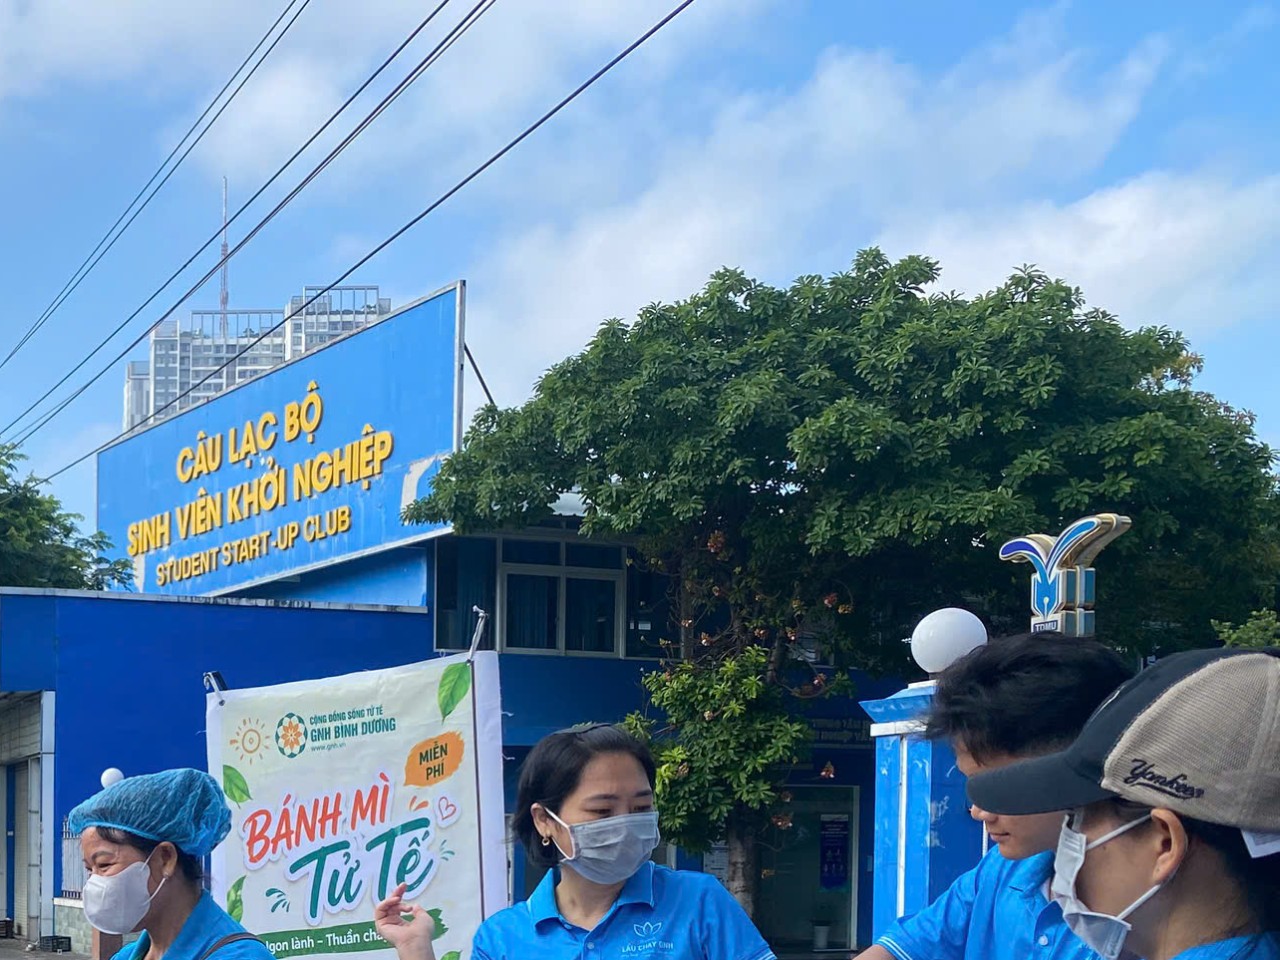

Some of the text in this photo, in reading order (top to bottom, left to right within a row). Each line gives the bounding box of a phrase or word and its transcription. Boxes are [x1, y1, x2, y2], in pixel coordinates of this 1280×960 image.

[176, 380, 323, 483] CÂU LẠC BỘ
[127, 424, 393, 557] SINH VIÊN KHỞI NGHIỆP
[156, 547, 220, 587] STUDENT
[304, 505, 351, 543] CLUB
[1035, 621, 1057, 632] TDMU
[309, 714, 327, 726] CỘNG
[347, 706, 365, 720] SỐNG
[310, 717, 396, 742] GNH BÌNH DƯƠNG
[419, 740, 448, 766] MIỄN
[426, 758, 444, 781] PHÍ
[242, 772, 390, 863] BÁNH MÌ
[289, 817, 434, 919] Tử Tế
[291, 936, 315, 950] lành
[326, 929, 360, 947] Thuần
[638, 941, 657, 951] CHAY
